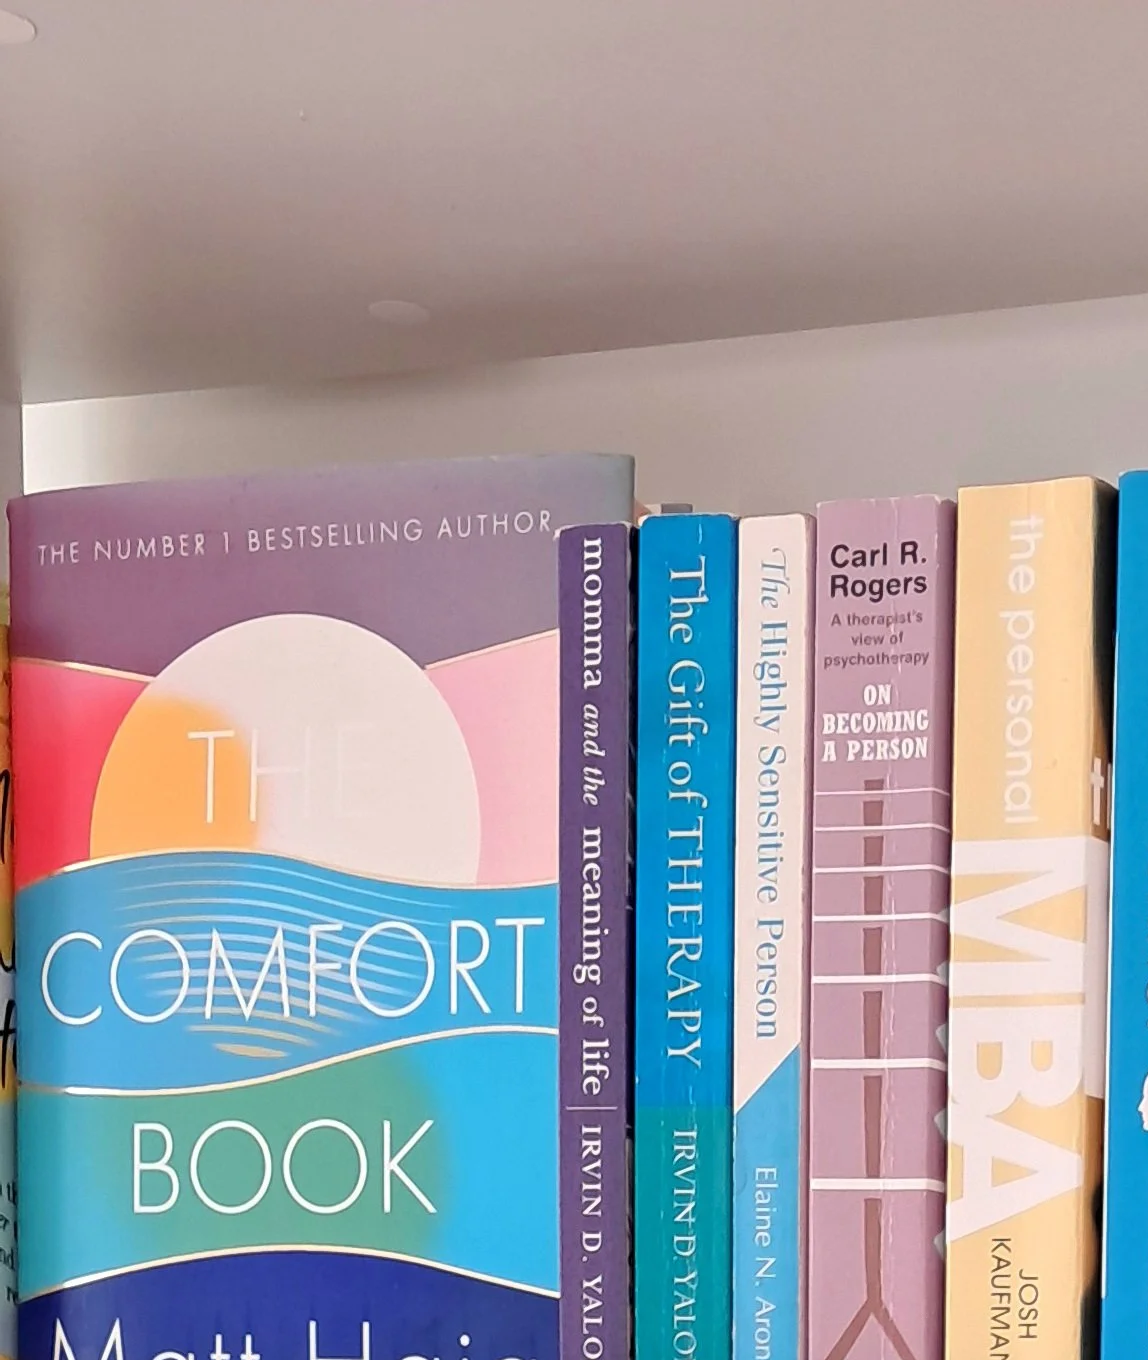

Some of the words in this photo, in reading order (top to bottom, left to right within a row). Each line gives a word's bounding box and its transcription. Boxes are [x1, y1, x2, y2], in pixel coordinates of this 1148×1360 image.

[37, 540, 81, 568] THE
[93, 532, 207, 563] NUMBER
[222, 531, 231, 555] 1
[247, 517, 425, 554] BESTSELLING
[829, 544, 889, 568] Carl
[900, 541, 929, 567] R.
[1007, 515, 1044, 594] the
[667, 555, 709, 644] The
[759, 547, 791, 609] The
[829, 574, 929, 604] Rogers
[581, 536, 603, 690] momma
[753, 620, 789, 734] Highly
[823, 655, 930, 670] psychotherapy
[667, 659, 708, 747] Gift
[821, 710, 930, 735] BECOMING
[863, 684, 893, 706] ON
[1000, 608, 1039, 824] personal
[581, 703, 606, 757] and
[821, 741, 838, 762] A
[844, 737, 929, 761] PERSON
[581, 765, 606, 806] the
[667, 760, 708, 809] of
[756, 745, 787, 904] Sensitive
[573, 826, 610, 985] meaning
[40, 916, 546, 1023] COMFORT
[665, 815, 705, 1069] THERAPY
[754, 917, 786, 1040] Person
[582, 996, 605, 1029] of
[581, 1038, 610, 1096] life
[132, 1117, 437, 1215] BOOK
